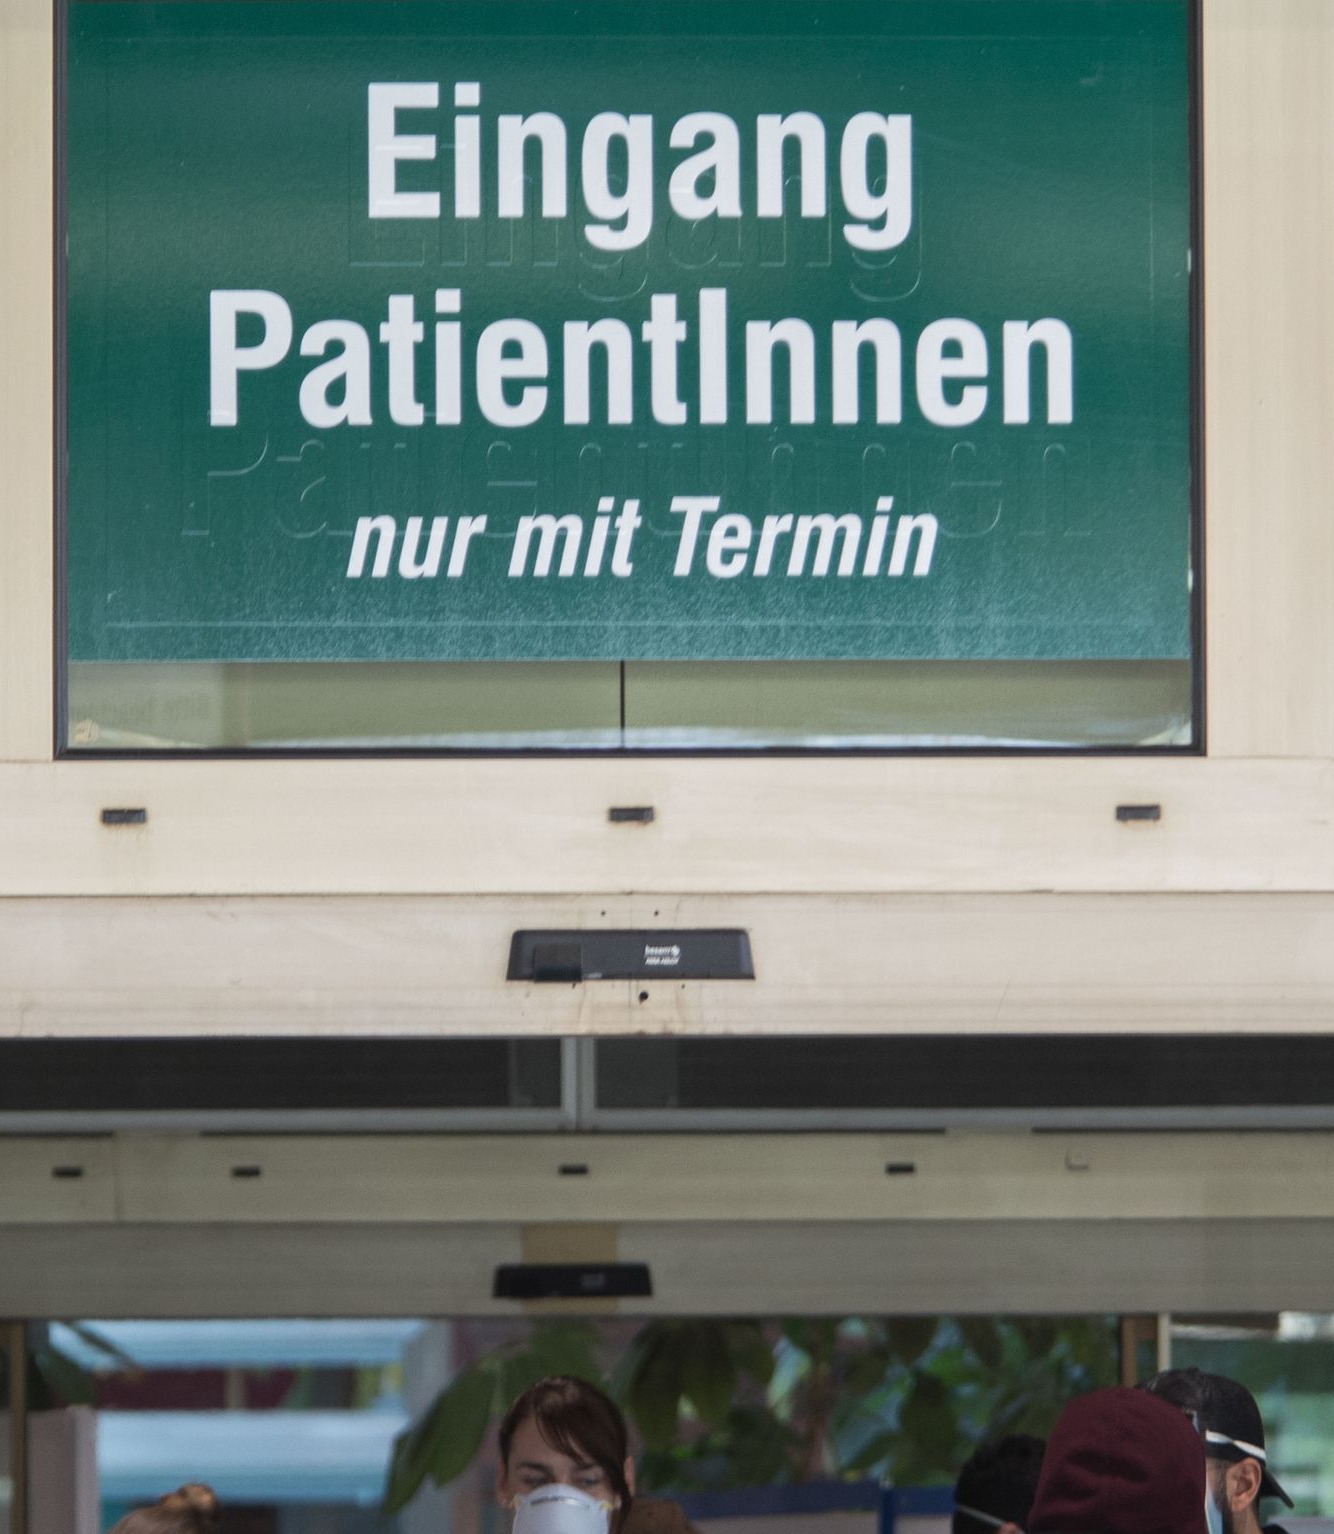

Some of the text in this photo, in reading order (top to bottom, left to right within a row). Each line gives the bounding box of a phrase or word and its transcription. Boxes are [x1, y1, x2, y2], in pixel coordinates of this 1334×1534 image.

[366, 81, 914, 251] Eingang
[208, 288, 1074, 428] PatientInnen
[346, 497, 940, 579] nur mit Termin
